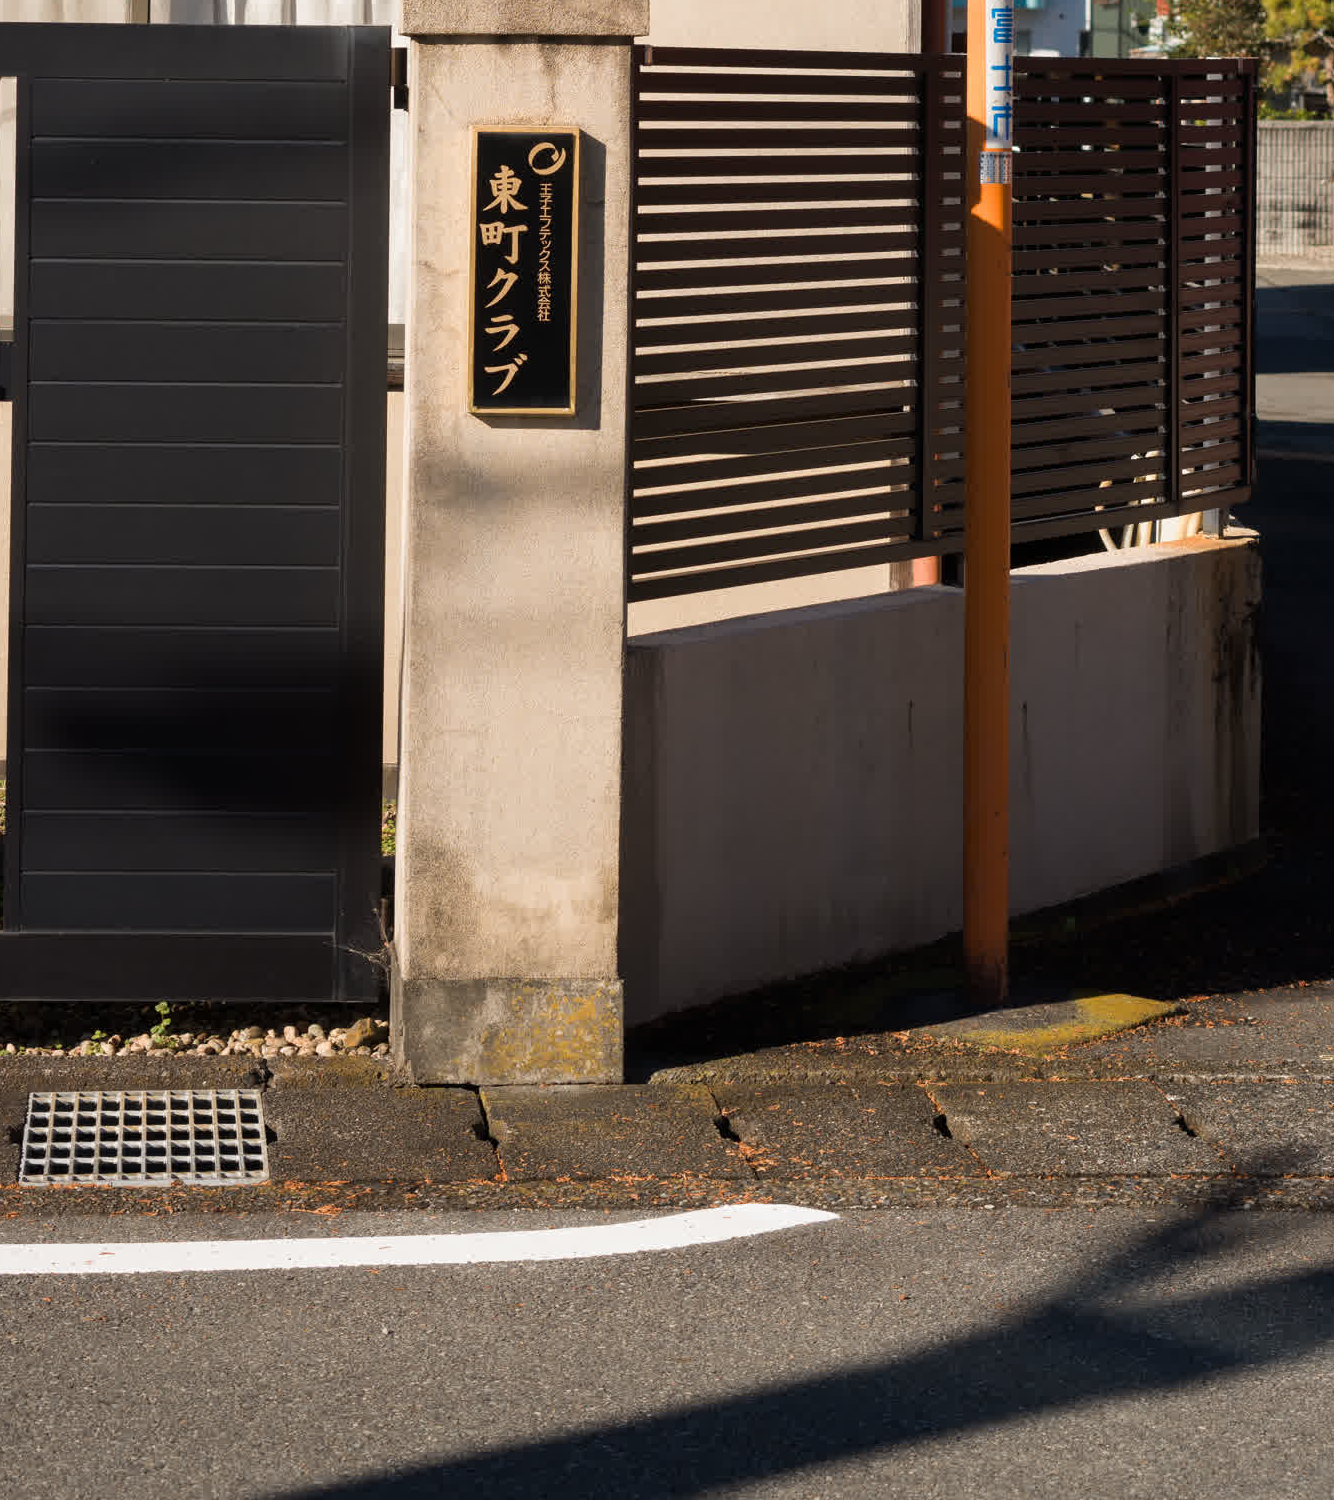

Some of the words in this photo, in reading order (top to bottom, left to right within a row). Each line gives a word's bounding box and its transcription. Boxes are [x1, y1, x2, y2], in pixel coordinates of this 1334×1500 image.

[478, 165, 529, 396] 東町クラブ
[536, 182, 552, 322] 王子エフテックス株式会社
